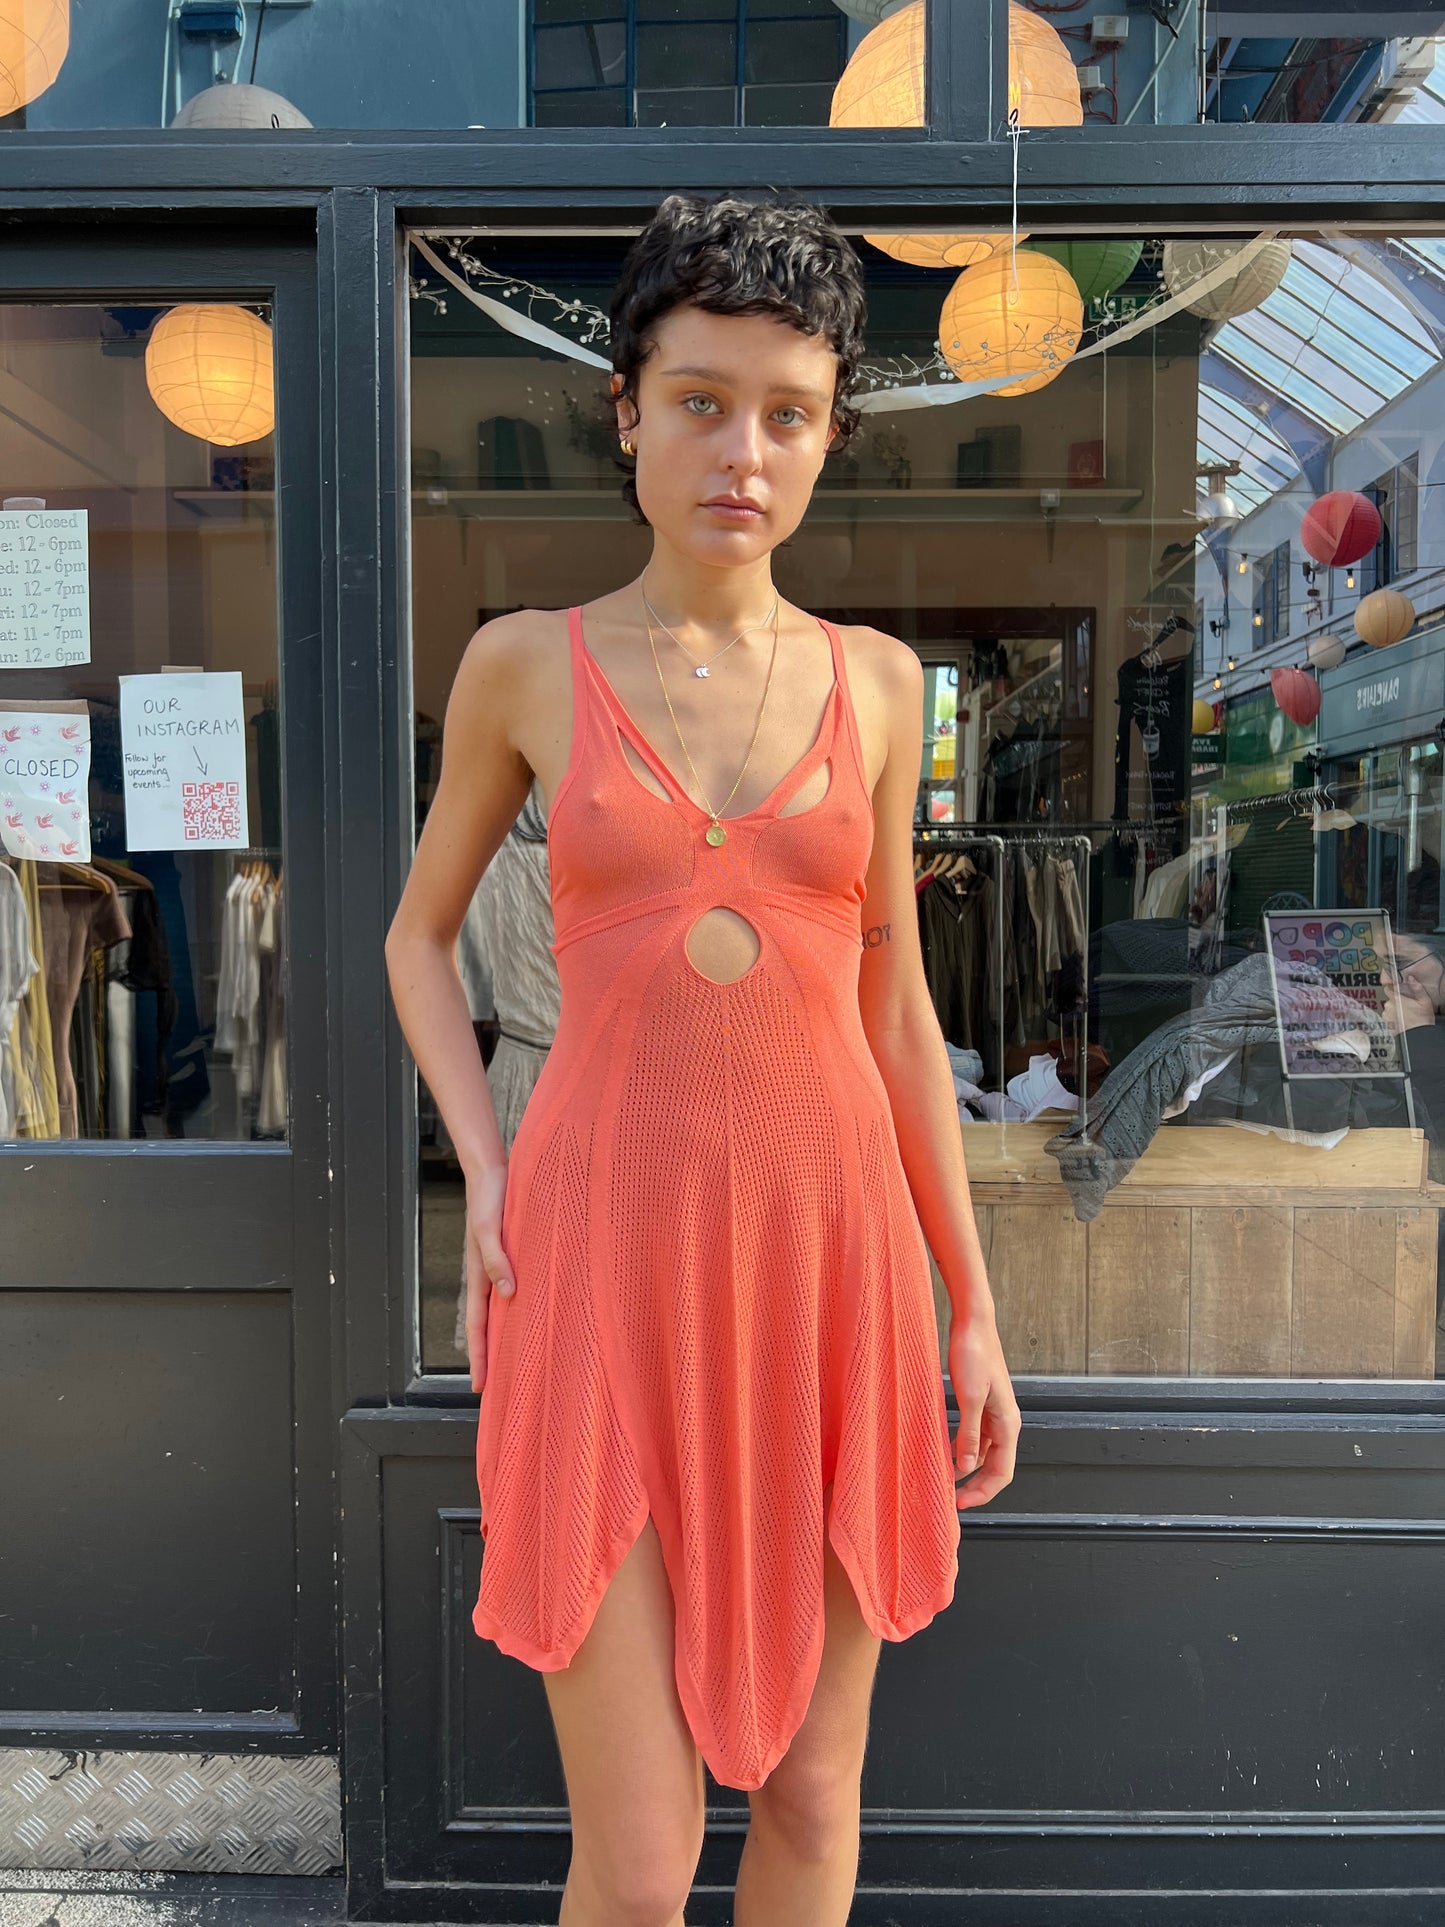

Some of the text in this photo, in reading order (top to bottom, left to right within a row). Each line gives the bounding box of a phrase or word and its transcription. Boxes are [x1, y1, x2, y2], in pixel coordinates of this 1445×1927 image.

[25, 513, 79, 529] Closed
[143, 697, 181, 714] OUR
[137, 718, 240, 737] INSTAGRAM
[5, 759, 79, 779] CLOSED
[124, 752, 167, 769] Follow for
[128, 767, 171, 782] upcoming
